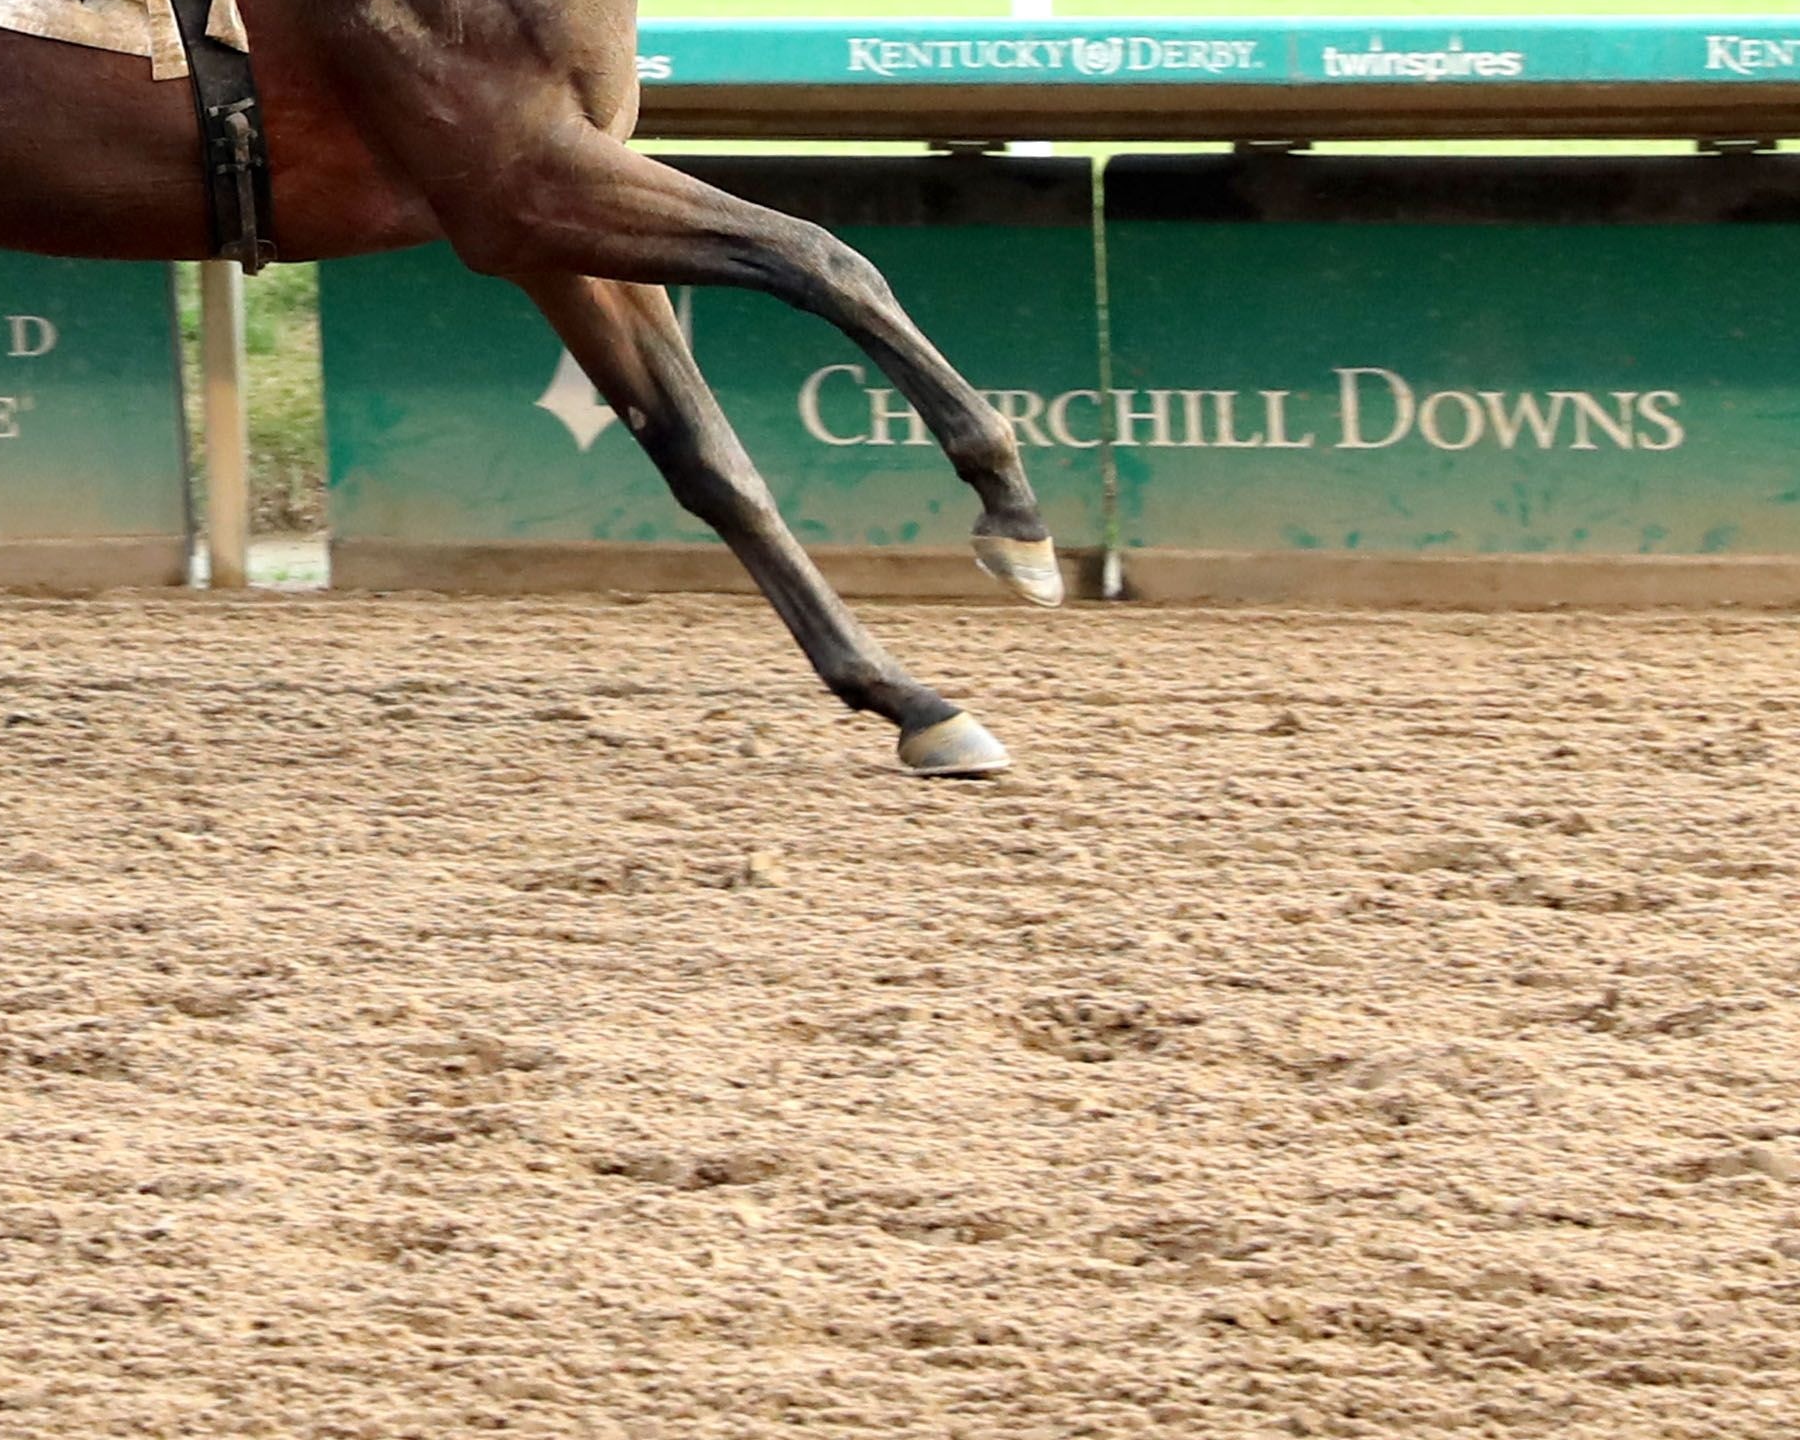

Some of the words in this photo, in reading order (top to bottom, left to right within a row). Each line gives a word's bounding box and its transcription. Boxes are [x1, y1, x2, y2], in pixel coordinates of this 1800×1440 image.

[847, 38, 1070, 76] KENTUCKY
[1126, 37, 1258, 73] DERBY
[1322, 35, 1524, 82] twinspires
[797, 363, 1314, 448] CHRCHILL
[1332, 366, 1686, 451] DOWNS
